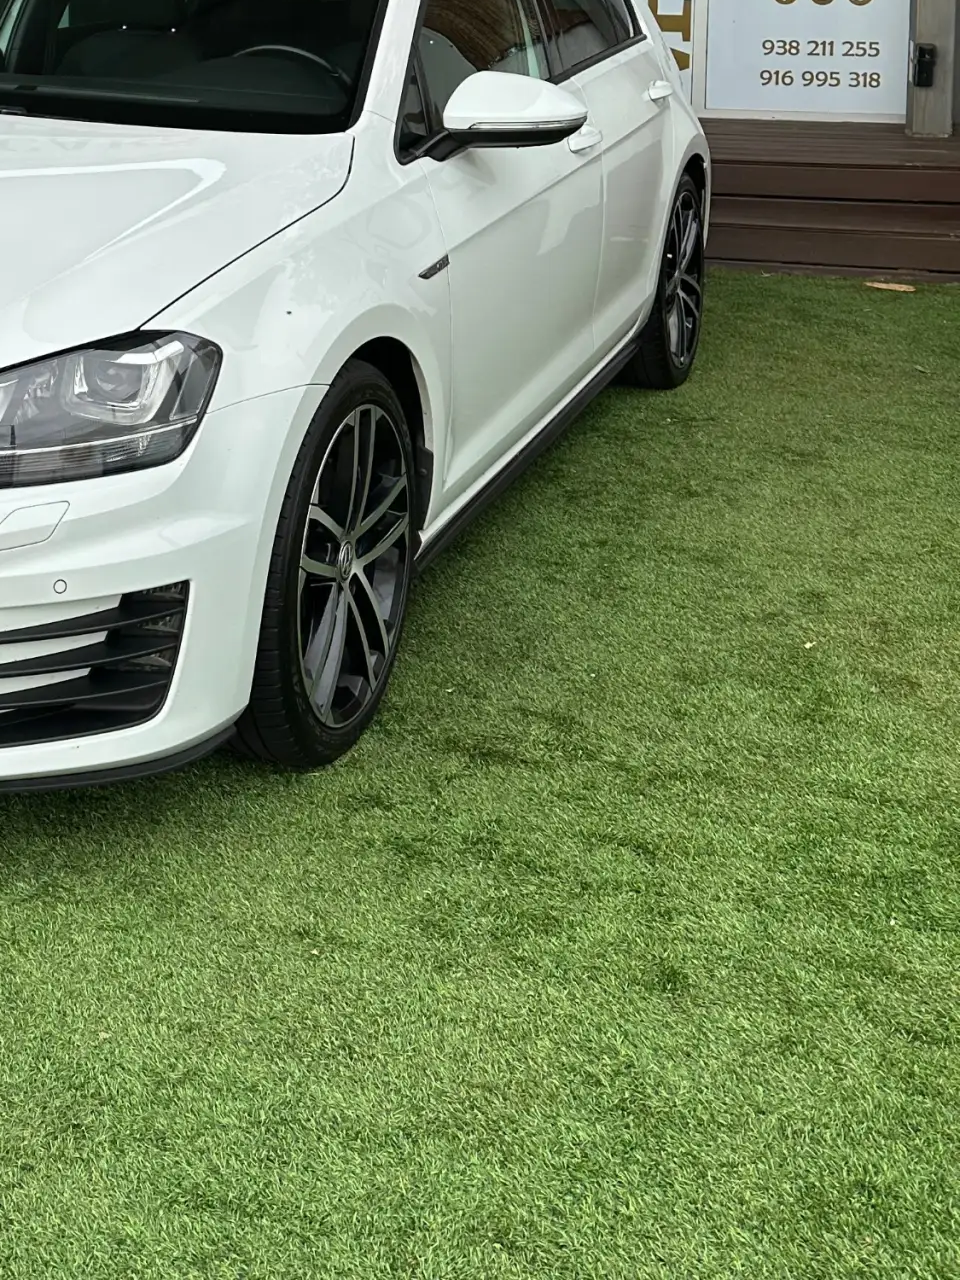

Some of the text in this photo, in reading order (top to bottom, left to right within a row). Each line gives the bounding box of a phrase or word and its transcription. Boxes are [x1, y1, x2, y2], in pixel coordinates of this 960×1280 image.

[762, 39, 880, 58] 938 211 255
[760, 70, 881, 89] 916 995 318
